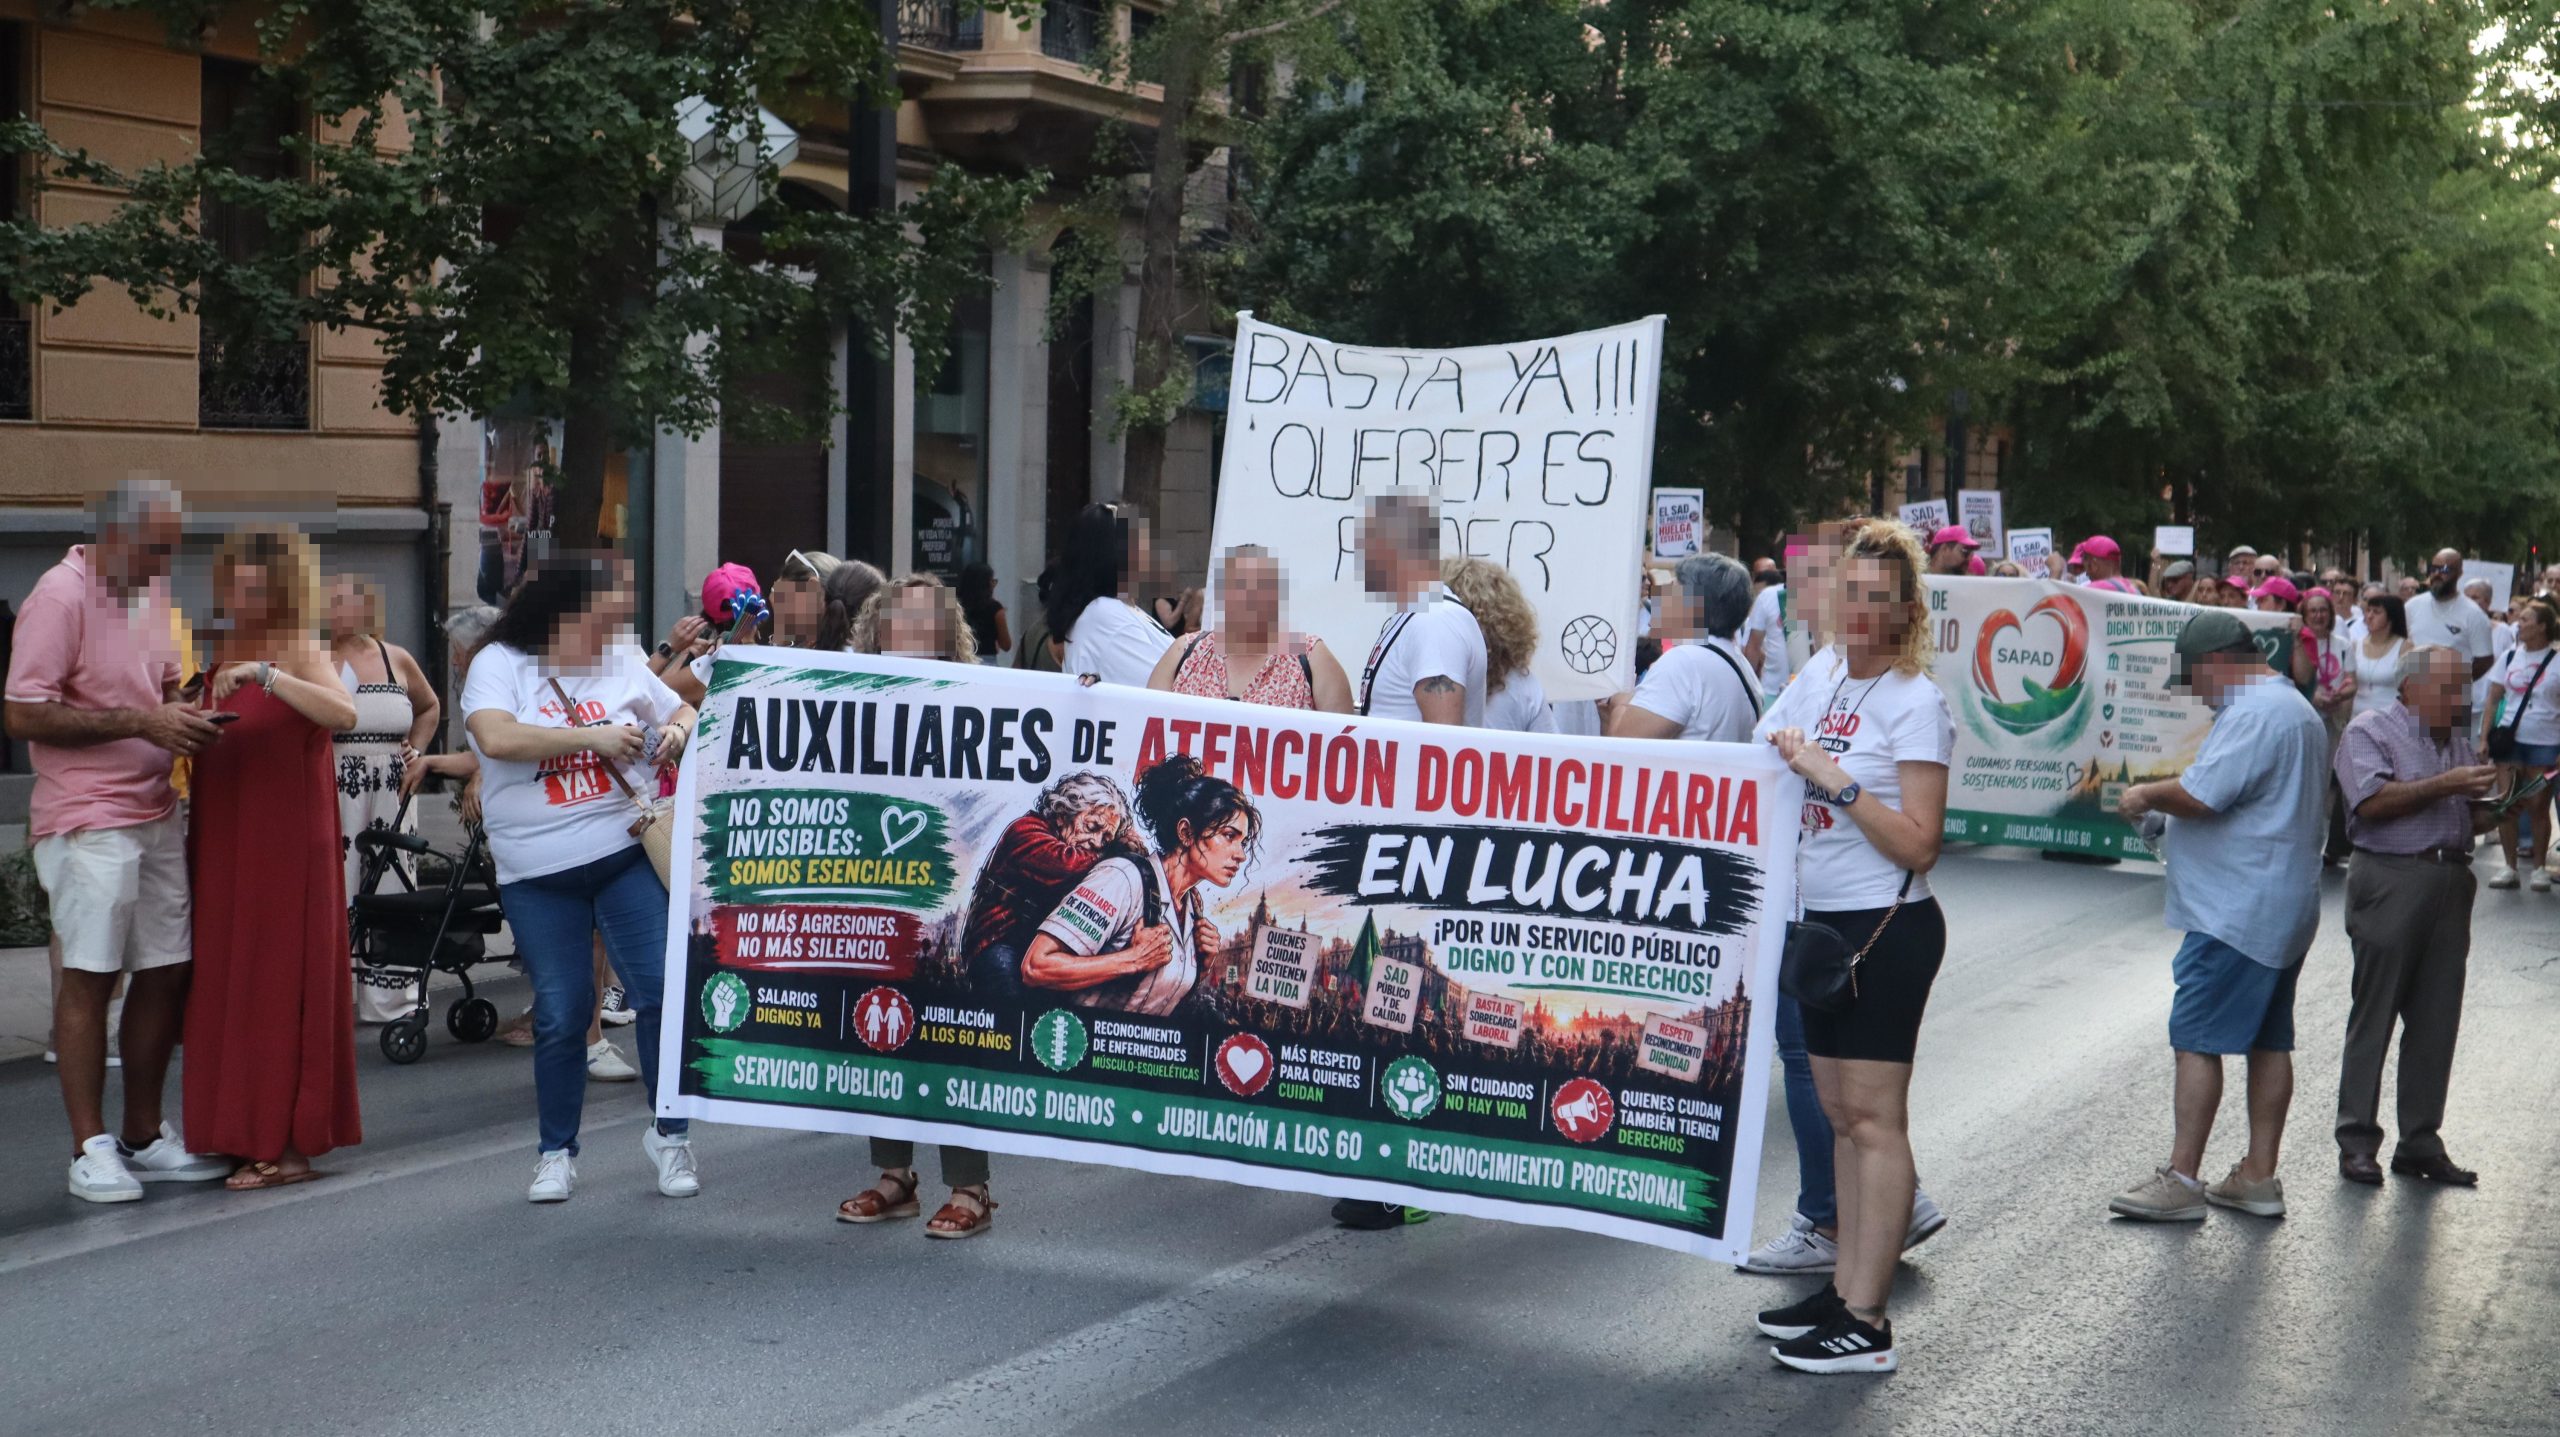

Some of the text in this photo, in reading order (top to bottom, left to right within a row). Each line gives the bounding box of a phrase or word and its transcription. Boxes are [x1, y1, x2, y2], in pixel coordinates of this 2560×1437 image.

[1245, 332, 1464, 412] BASTA
[1542, 429, 1616, 506] ES
[1671, 504, 1690, 515] SAD
[1932, 590, 1948, 611] DE
[2107, 621, 2134, 636] DIGNO
[2137, 621, 2143, 636] Y
[2145, 621, 2163, 635] CON
[1997, 647, 2054, 667] SAPAD
[727, 697, 1053, 784] AUXILIARES
[1072, 718, 1117, 765] DE
[1132, 716, 1399, 808] ATENCIÓN
[1415, 744, 1759, 846] DOMICILIARIA
[1966, 756, 2011, 771] CUIDAMOS
[557, 768, 600, 800] YA!
[1962, 773, 2063, 792] SOSTENEMOS VIDAS
[728, 797, 850, 827] NO SOMOS
[727, 828, 863, 857] INVISIBLES:
[2003, 824, 2091, 847] JUBILACIÓN A LOS 60
[729, 859, 935, 887] SOMOS ESENCIALES.
[1357, 832, 1709, 928] EN LUCHA
[1066, 896, 1110, 931] DE ATENCIÓN
[1074, 886, 1117, 917] AUXILIARES
[736, 909, 899, 937] NO MÁS AGRESIONES.
[1056, 906, 1103, 944] DOMICILIARIA
[737, 933, 890, 961] NO MÁS SILENCIO.
[1266, 930, 1307, 950] QUIENES
[1434, 918, 1721, 969] ¡POR UN SERVICIO PÚBLICO
[1266, 946, 1302, 966] CUIDAN
[1255, 959, 1308, 983] SOSTIENEN
[1383, 965, 1409, 986] SAD
[1447, 947, 1713, 997] DIGNO Y CON DERECHOS!
[756, 987, 817, 1009] SALARIOS
[1255, 976, 1300, 1001] LA VIDA
[1376, 979, 1411, 999] PÚBLICO
[1372, 1006, 1407, 1025] CALIDAD
[1382, 996, 1401, 1010] Y DE
[1475, 997, 1515, 1017] BASTA DE
[755, 1006, 822, 1029] DIGNOS YA
[920, 1004, 995, 1029] JUBILACIÓN
[1469, 1010, 1517, 1030] SOBRECARGA
[919, 1025, 1012, 1052] A LOS 60 AÑOS
[1094, 1020, 1182, 1045] RECONOCIMIENTO
[1472, 1025, 1510, 1043] LABORAL
[1659, 1021, 1694, 1042] RESPETO
[1093, 1038, 1187, 1063] DE ENFERMEDADES
[1281, 1044, 1361, 1071] MÁS RESPETO
[1644, 1034, 1702, 1059] RECONOCIMIENTO
[1092, 1055, 1200, 1082] MÚSCULO-ESQUELÉTICAS
[1649, 1050, 1690, 1073] DIGNIDAD
[1279, 1065, 1360, 1090] PARA QUIENES
[1446, 1073, 1534, 1100] SIN CUIDADOS
[1278, 1081, 1324, 1103] CUIDAN
[1445, 1096, 1527, 1119] NO HAY VIDA
[1620, 1090, 1722, 1121] QUIENES CUIDAN
[733, 1054, 1687, 1212] SERVICIO PÚBLICO SALARIOS DIGNOS JUBILACIÓN A LOS 60 RECONOCIMIENTO PROFESIONAL
[1620, 1107, 1720, 1142] TAMBIÉN TIENEN
[1618, 1128, 1685, 1154] DERECHOS
